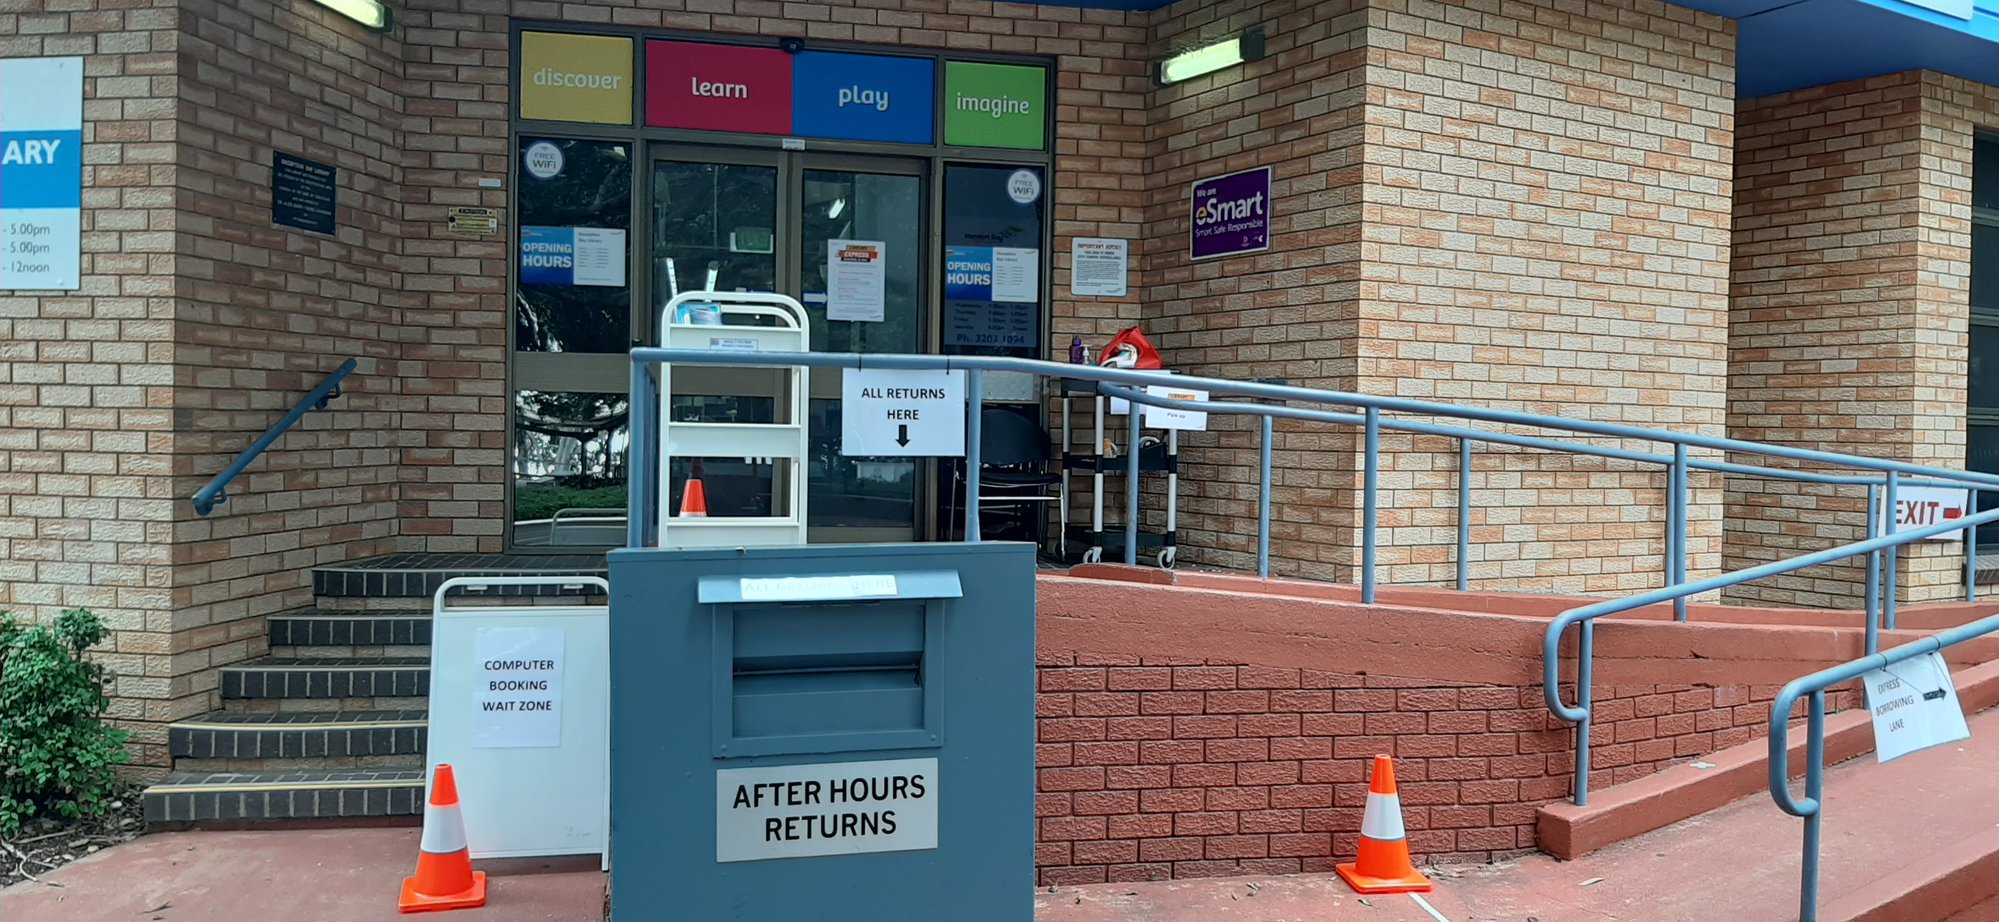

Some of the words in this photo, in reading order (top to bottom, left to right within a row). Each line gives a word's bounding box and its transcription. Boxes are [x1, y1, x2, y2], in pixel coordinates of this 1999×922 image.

[533, 68, 622, 90] discover
[692, 77, 748, 98] learn
[838, 85, 890, 111] play
[956, 92, 1030, 118] imagine
[1207, 188, 1217, 196] are
[1196, 191, 1263, 226] eSmart
[10, 223, 50, 237] 5.00pm
[1195, 227, 1213, 238] Smart
[1213, 225, 1227, 235] Safe
[10, 241, 50, 256] 5.00pm
[523, 242, 572, 253] OPENING
[11, 261, 50, 273] 12noon
[523, 254, 572, 268] HOURS
[947, 261, 991, 272] OPENING
[947, 273, 991, 285] HOURS
[975, 334, 998, 343] 3203
[861, 388, 883, 398] ALL
[887, 388, 945, 399] RETURNS
[887, 409, 919, 420] HERE
[1896, 500, 1939, 525] EXIT
[484, 660, 554, 670] COMPUTER
[489, 680, 548, 691] BOOKING
[1877, 678, 1901, 694] EXPRESS
[482, 701, 516, 711] WAIT
[519, 700, 552, 711] ZONE
[1875, 695, 1914, 717] BORROWING
[1889, 718, 1904, 733] LANE
[732, 781, 822, 809] AFTER
[830, 774, 926, 803] HOURS
[765, 810, 897, 842] RETURNS
